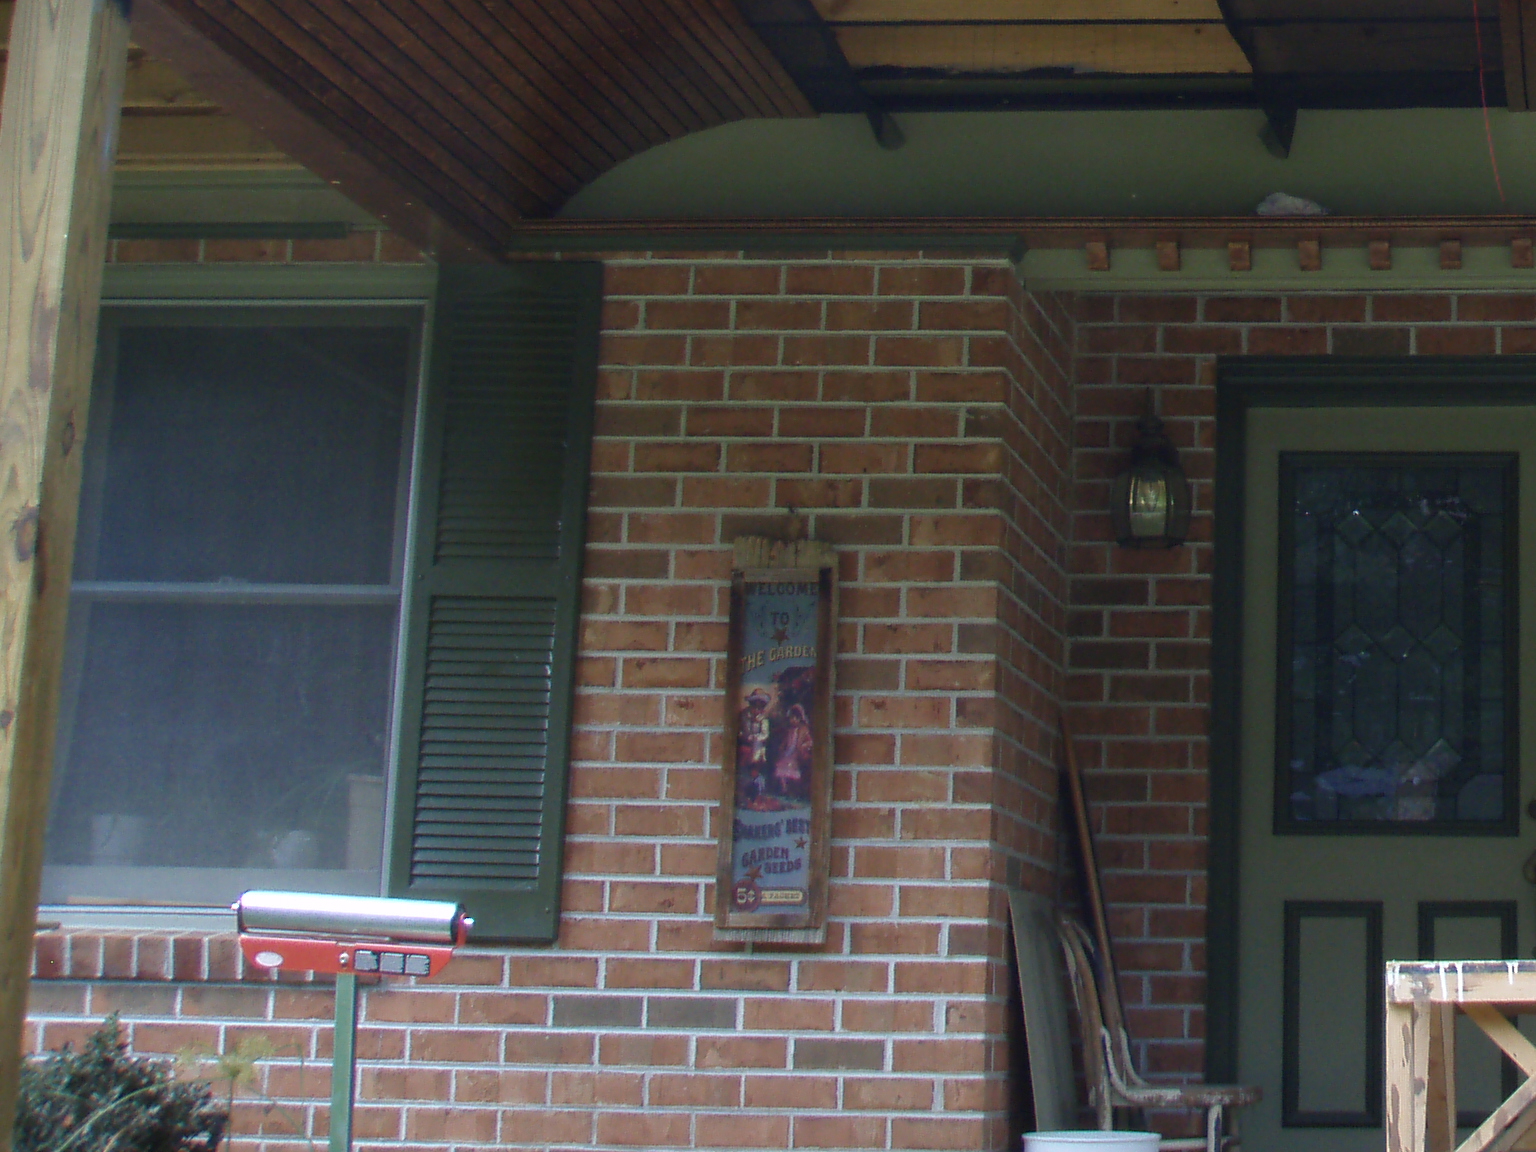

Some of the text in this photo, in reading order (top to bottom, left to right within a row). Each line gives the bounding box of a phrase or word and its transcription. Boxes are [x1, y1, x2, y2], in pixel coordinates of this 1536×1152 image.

[745, 582, 819, 596] WELCOME
[770, 612, 789, 625] TO
[739, 645, 817, 674] THE GARDEN
[742, 846, 789, 868] GARDEN
[764, 858, 802, 874] SEEDS
